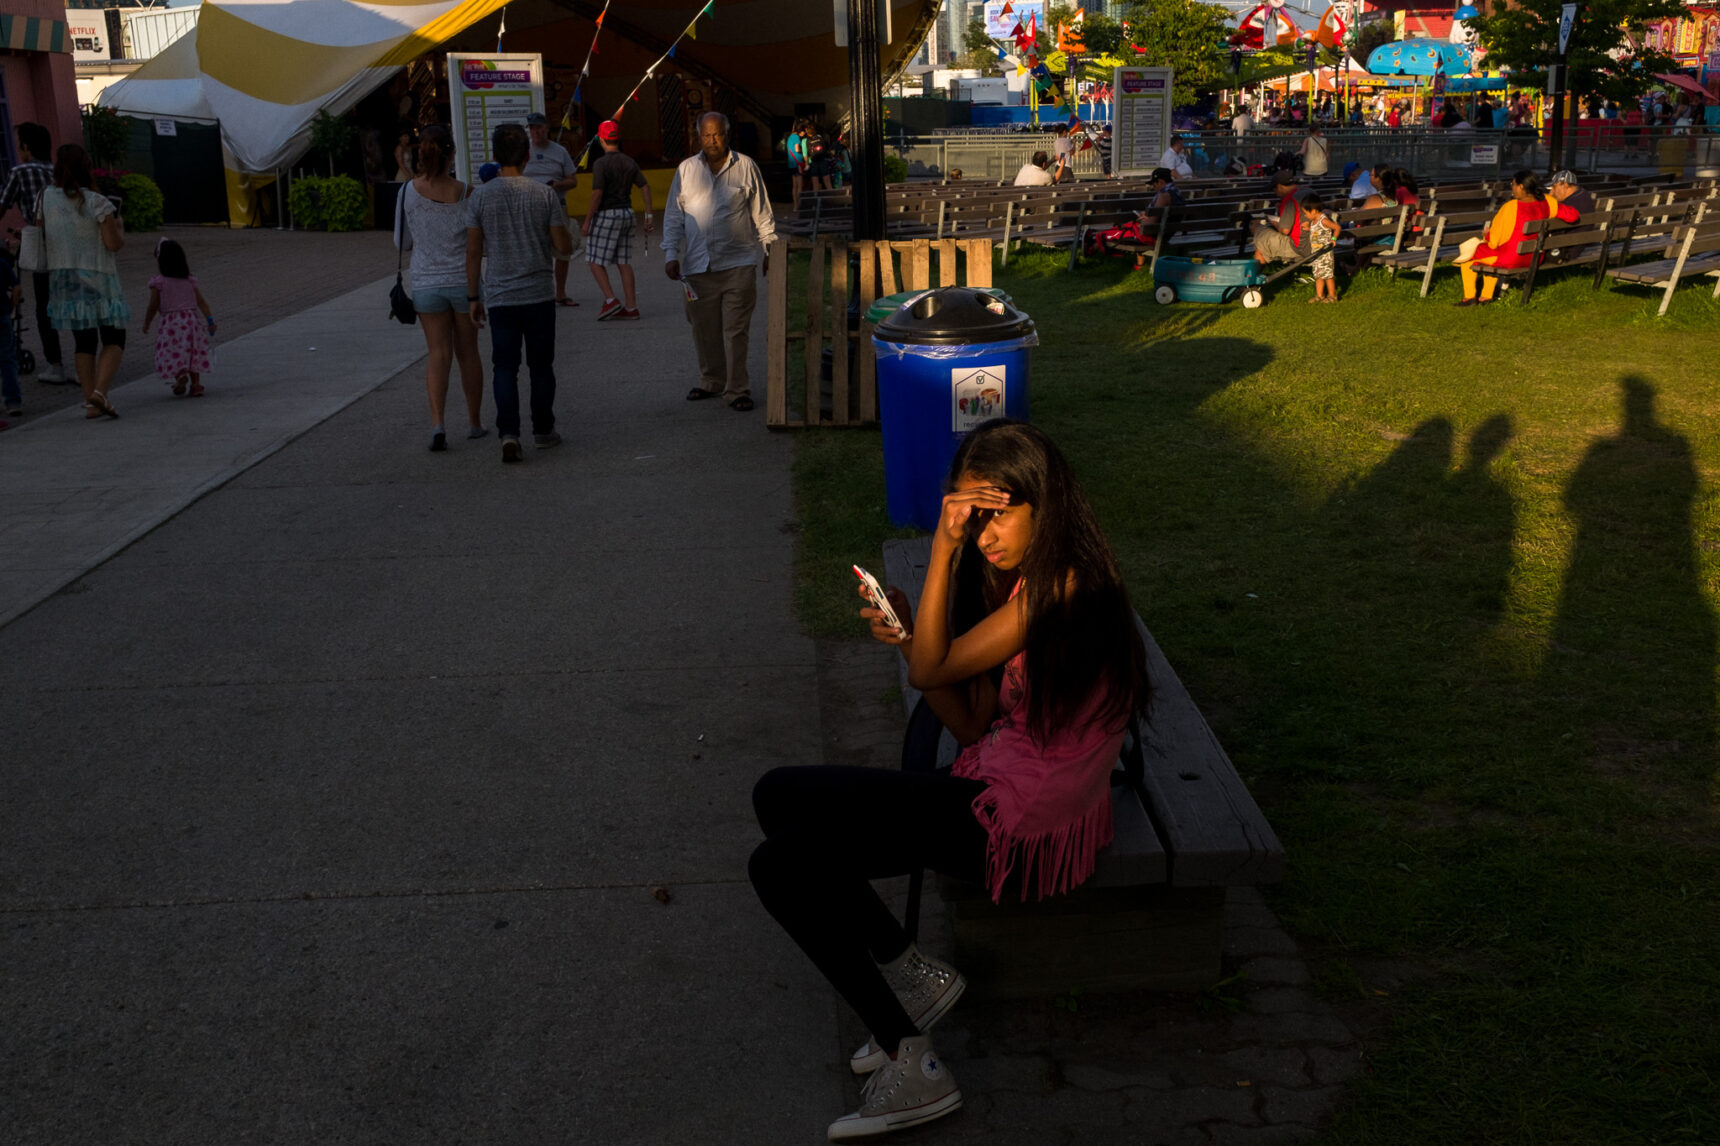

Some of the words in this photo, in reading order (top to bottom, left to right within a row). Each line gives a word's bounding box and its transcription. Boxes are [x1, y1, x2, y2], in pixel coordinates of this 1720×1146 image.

[69, 27, 96, 35] NETFLIX
[470, 73, 502, 81] FEATURE
[503, 73, 526, 81] STAGE
